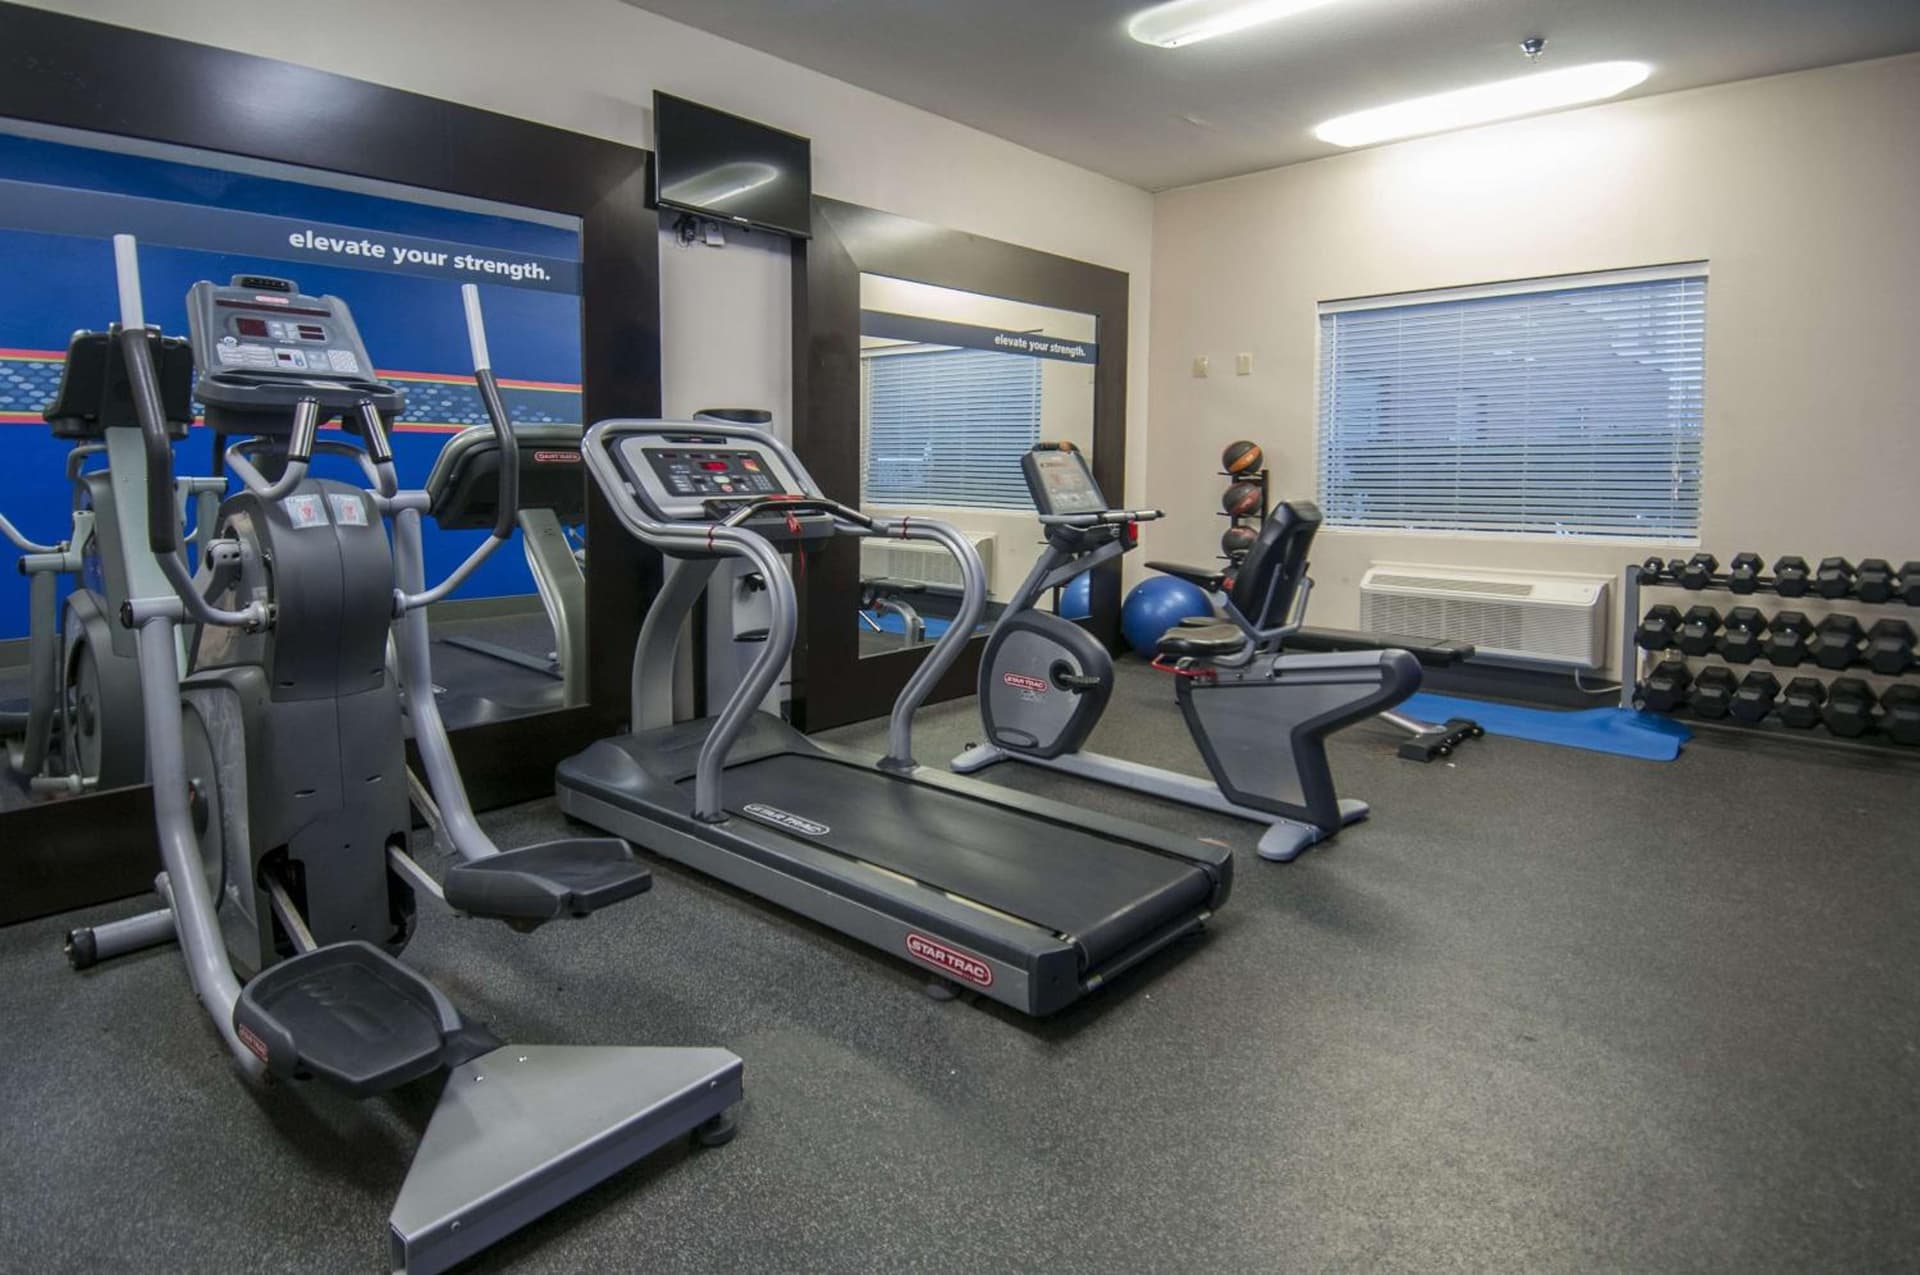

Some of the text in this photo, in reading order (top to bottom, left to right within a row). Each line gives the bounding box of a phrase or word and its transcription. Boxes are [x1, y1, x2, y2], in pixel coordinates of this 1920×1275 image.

[289, 230, 551, 281] elevate your strength.
[994, 333, 1087, 358] elevate your strength.
[911, 939, 985, 979] STAR TRAC
